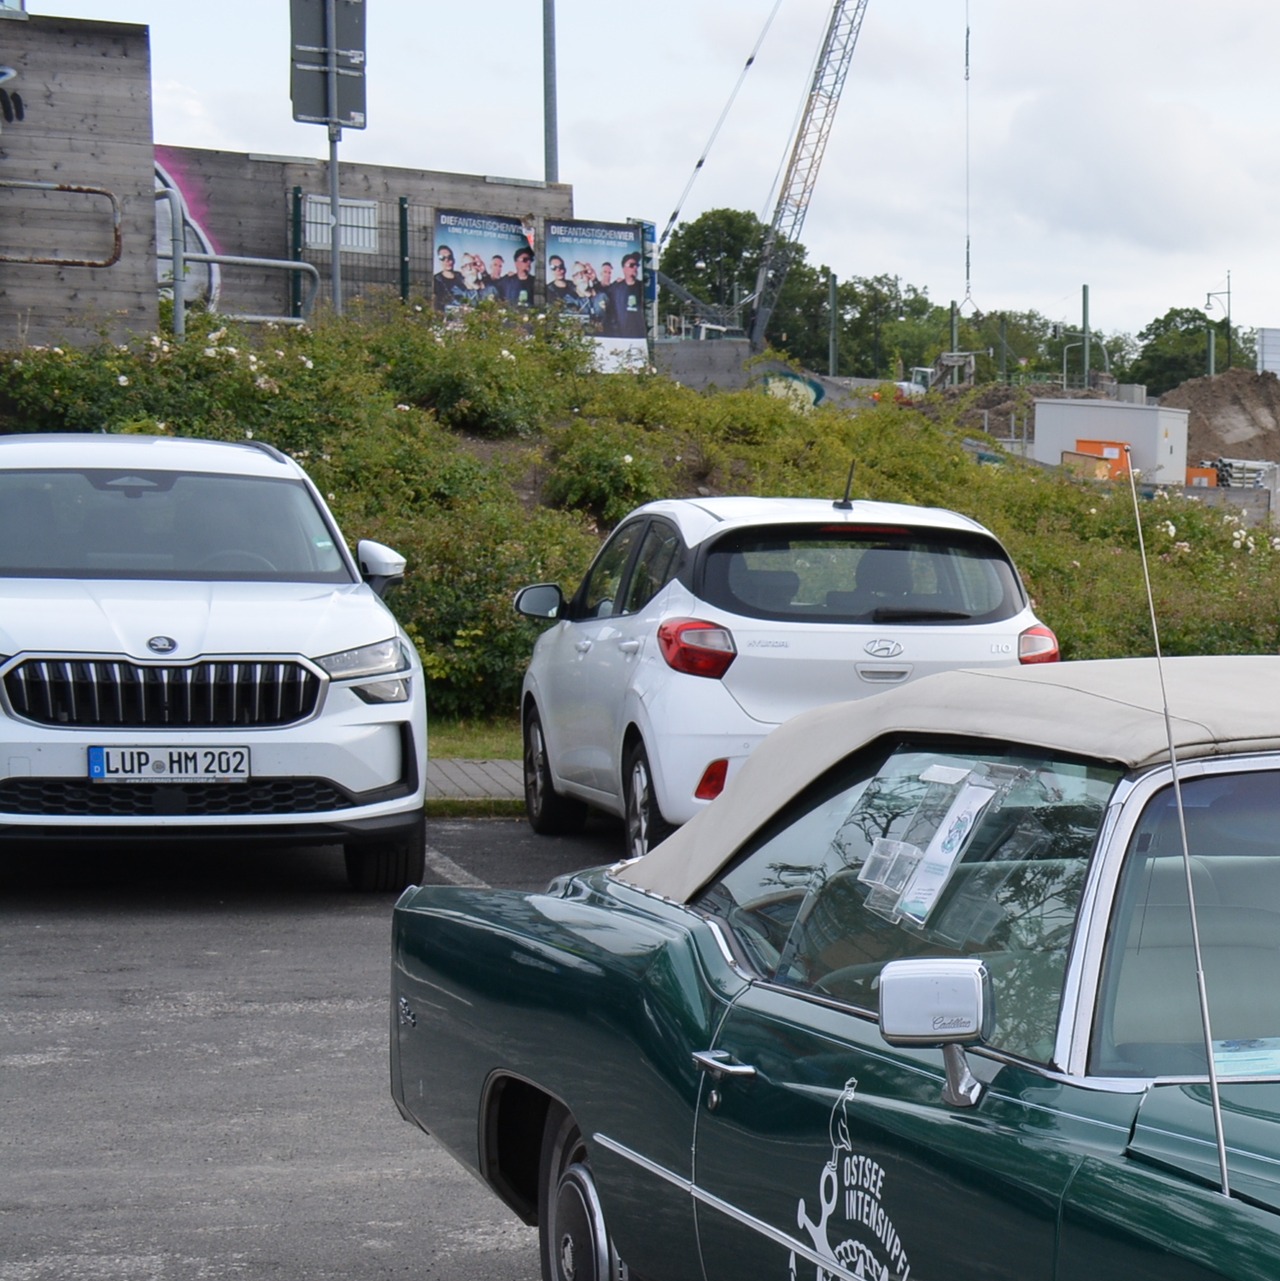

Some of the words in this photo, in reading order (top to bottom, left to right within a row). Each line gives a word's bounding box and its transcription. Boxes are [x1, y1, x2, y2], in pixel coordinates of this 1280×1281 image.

[550, 225, 635, 242] DIEFANTASTISCHENVIER
[105, 751, 150, 774] LUP
[168, 751, 198, 774] HM
[203, 751, 245, 774] 202
[932, 1016, 971, 1030] Cadillac
[843, 1155, 886, 1200] OSTSEE
